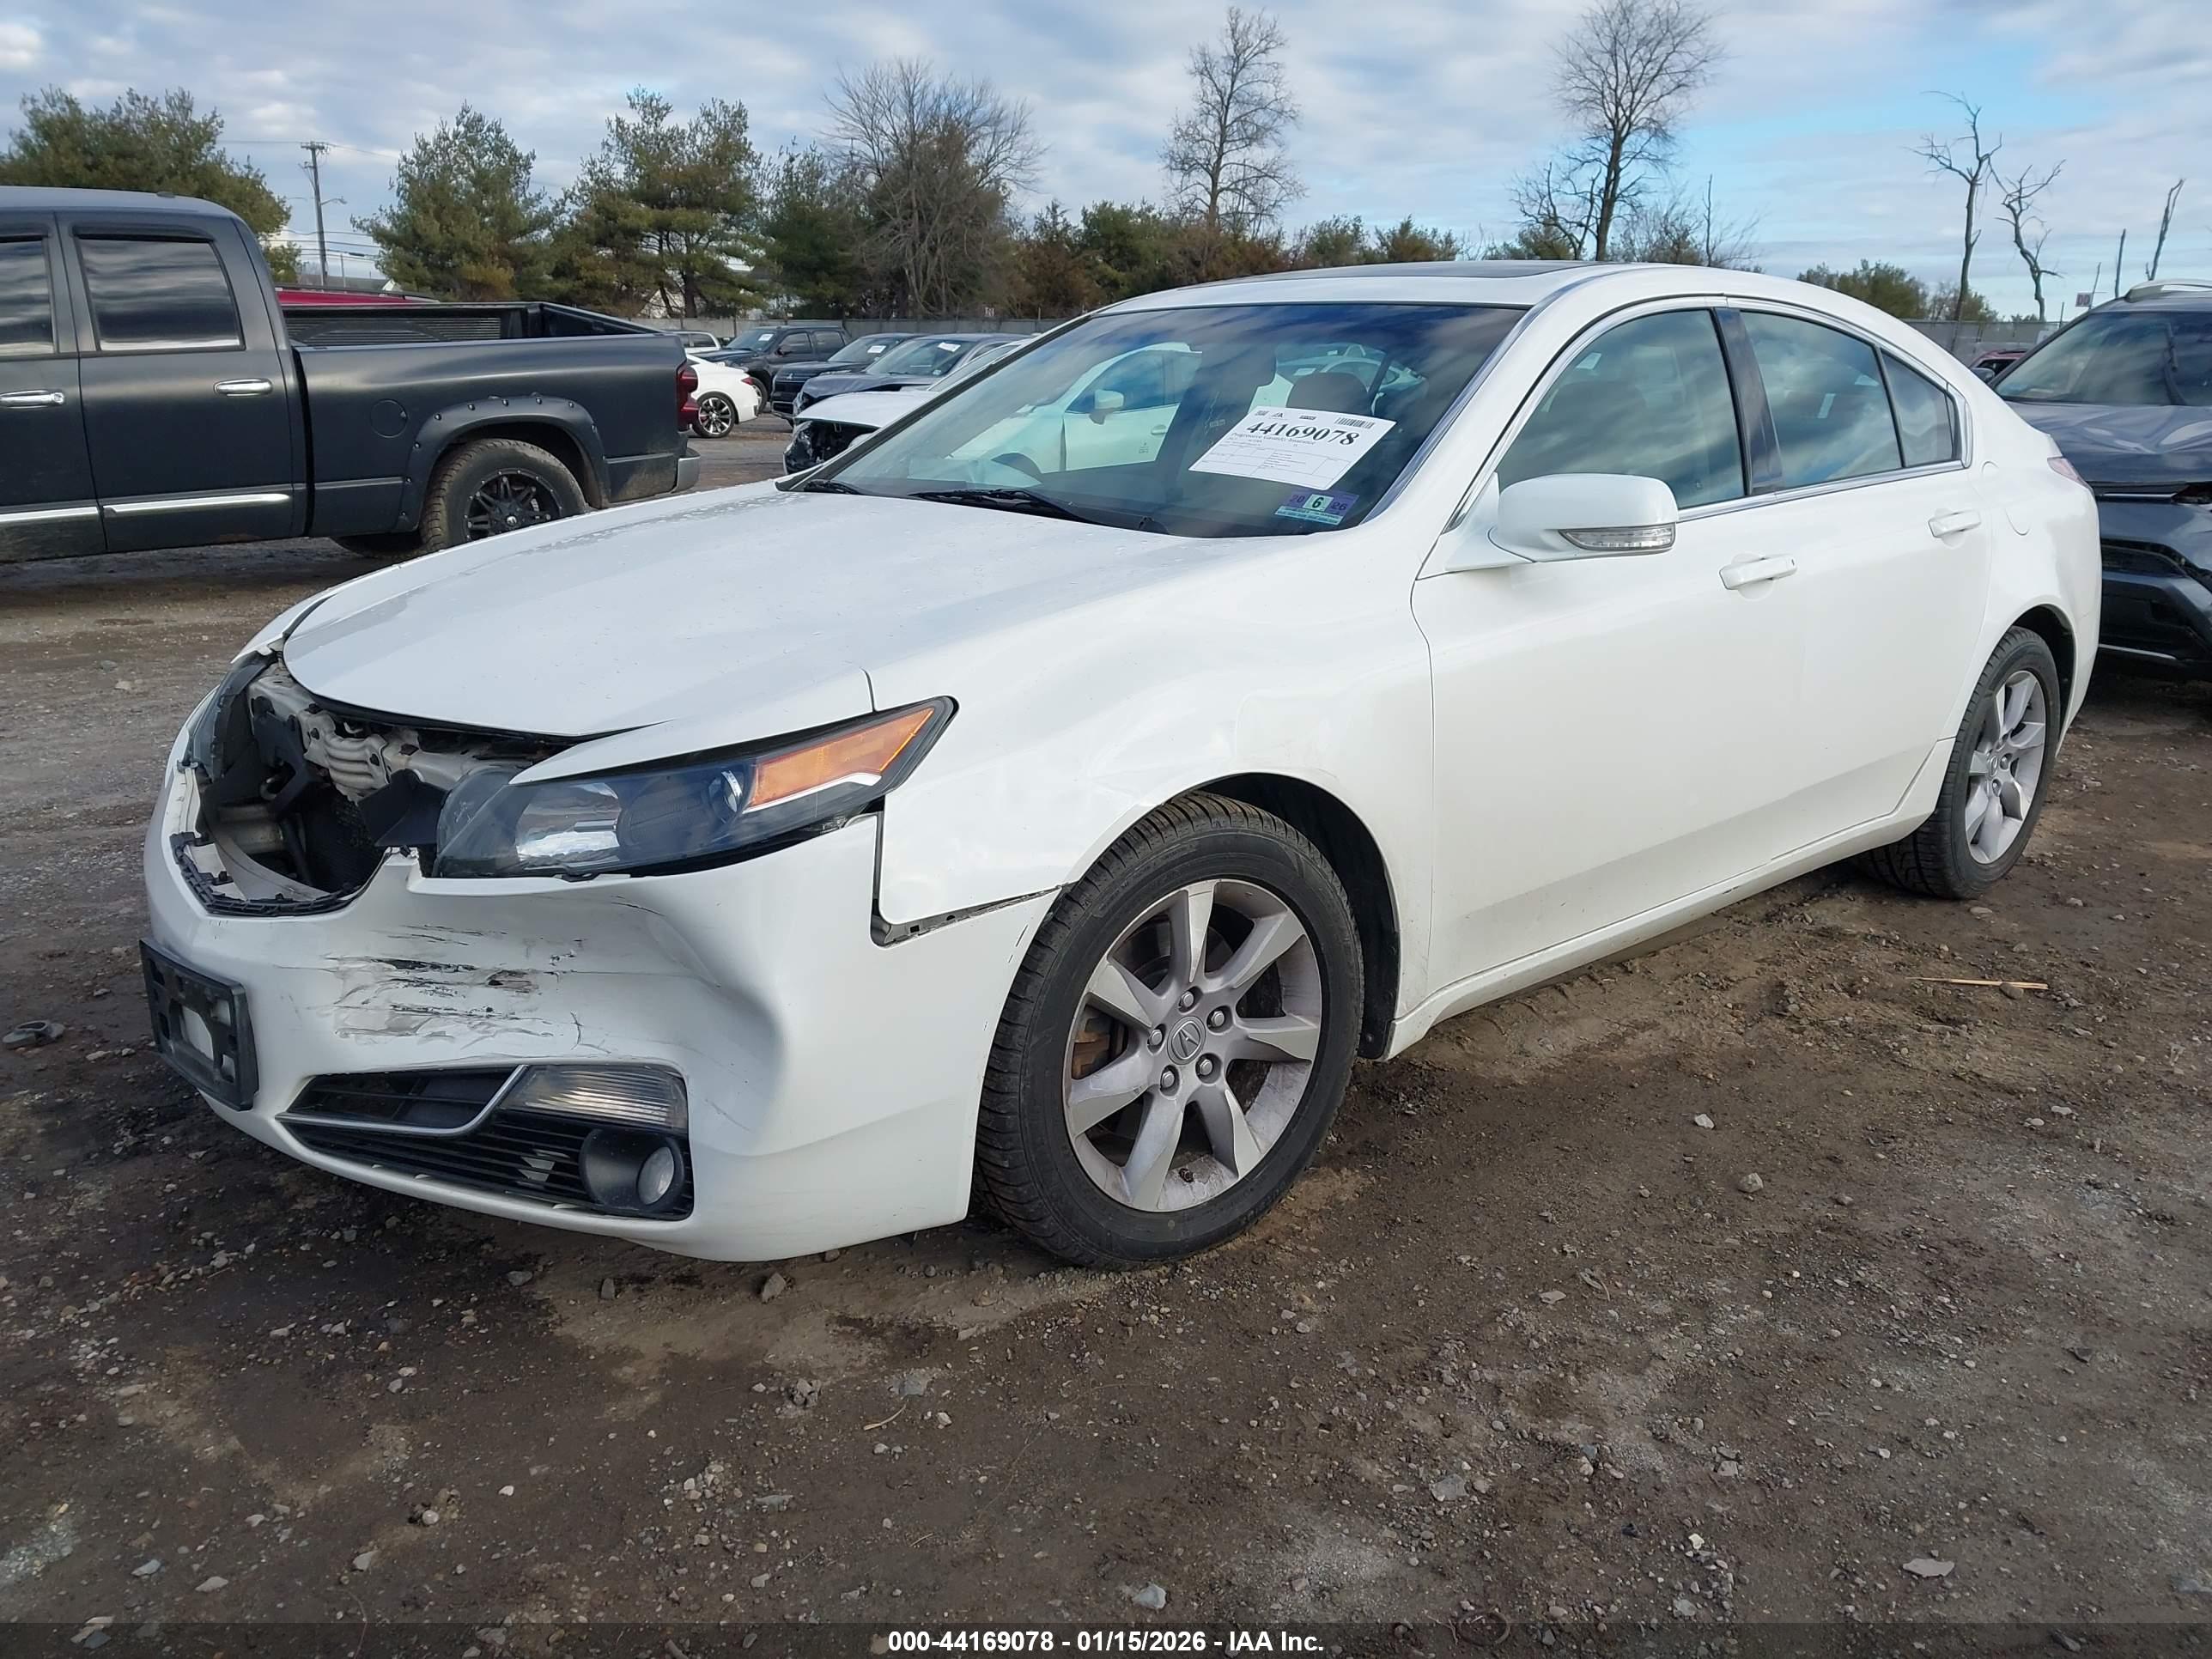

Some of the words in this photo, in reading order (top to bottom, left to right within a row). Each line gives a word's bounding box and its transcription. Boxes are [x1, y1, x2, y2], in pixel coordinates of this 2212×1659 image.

[1247, 421, 1360, 446] 44169078
[1290, 495, 1305, 503] 20
[1312, 496, 1324, 508] 6
[1330, 501, 1347, 511] 26
